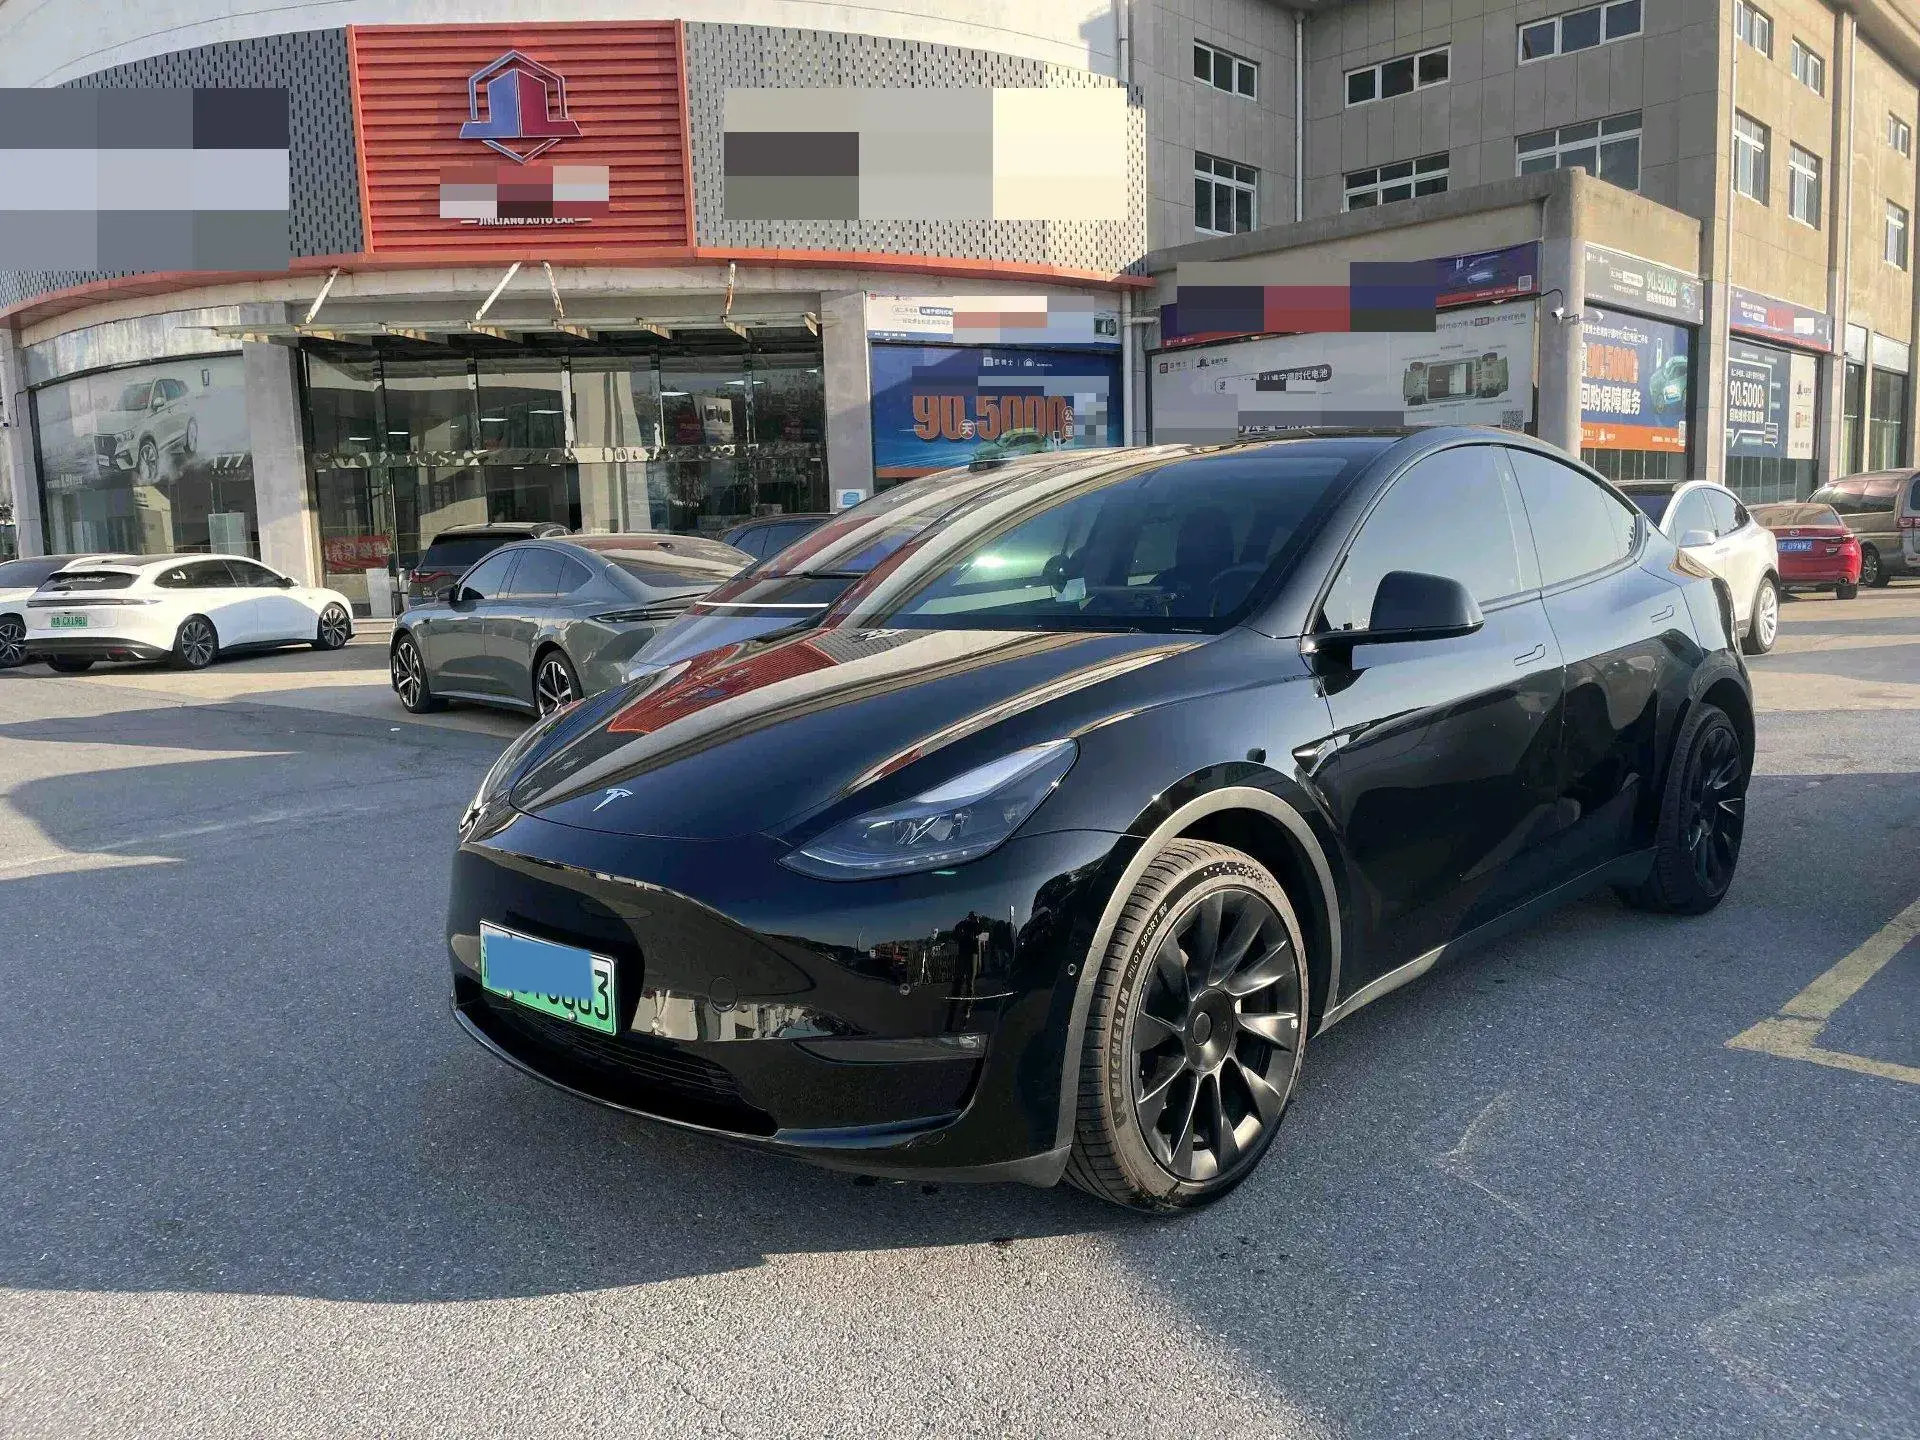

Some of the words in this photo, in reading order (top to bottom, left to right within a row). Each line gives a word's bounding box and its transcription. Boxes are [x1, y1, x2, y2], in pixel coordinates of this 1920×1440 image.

[1111, 987, 1130, 1099] MICHELIN
[1127, 947, 1142, 980] PILOT
[1140, 915, 1160, 948] SPORT
